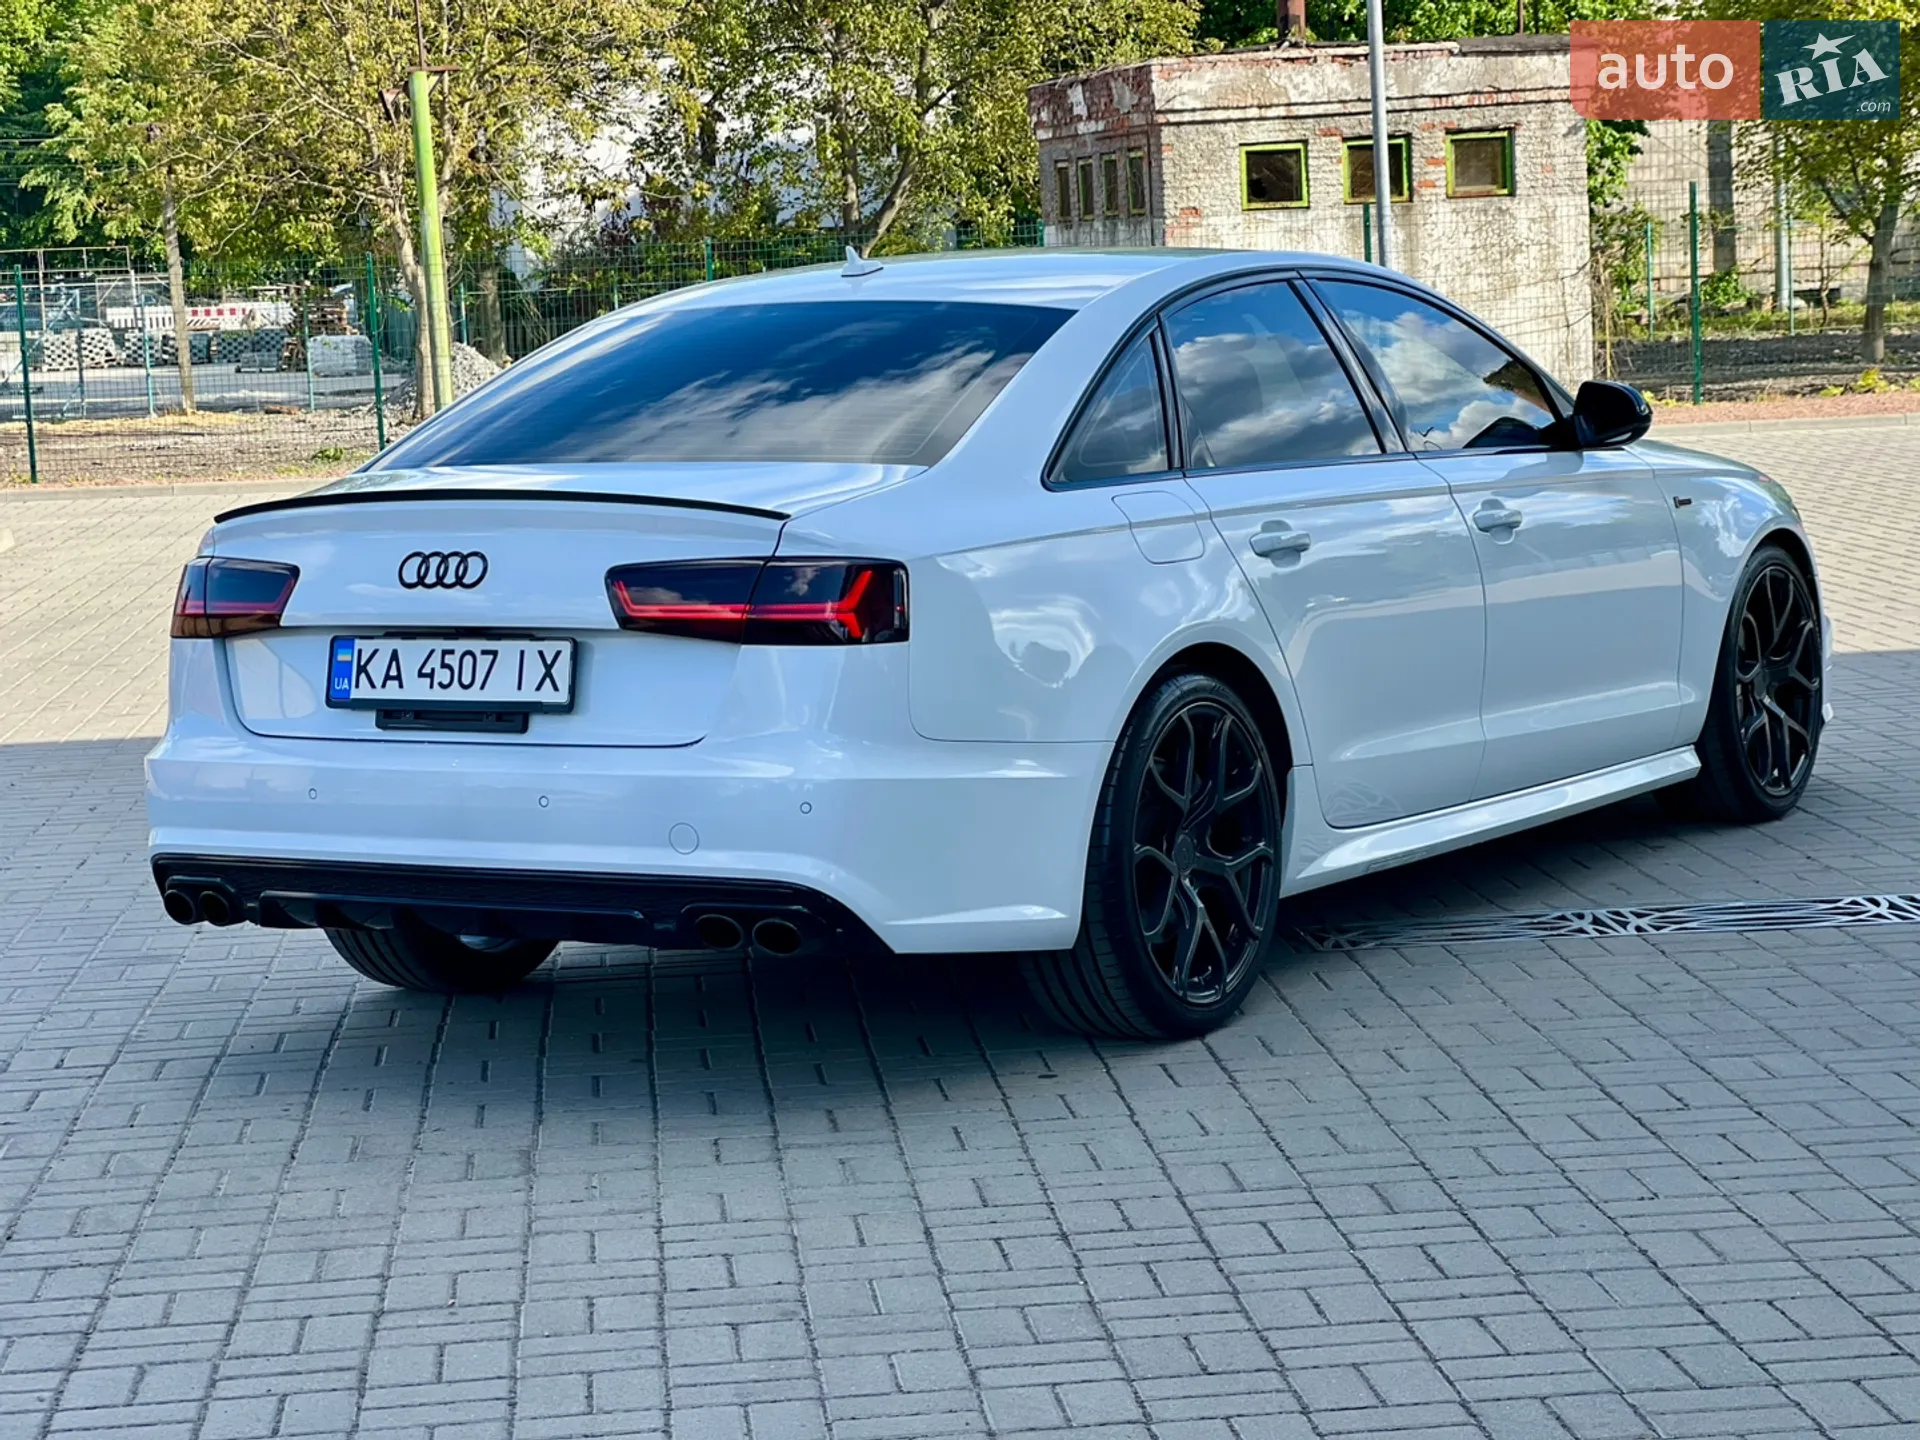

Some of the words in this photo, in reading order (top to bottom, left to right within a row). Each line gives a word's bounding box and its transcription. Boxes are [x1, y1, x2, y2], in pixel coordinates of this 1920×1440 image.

[334, 677, 350, 690] UA
[354, 648, 404, 690] KA
[417, 648, 499, 691] 4507
[516, 649, 563, 692] IX
